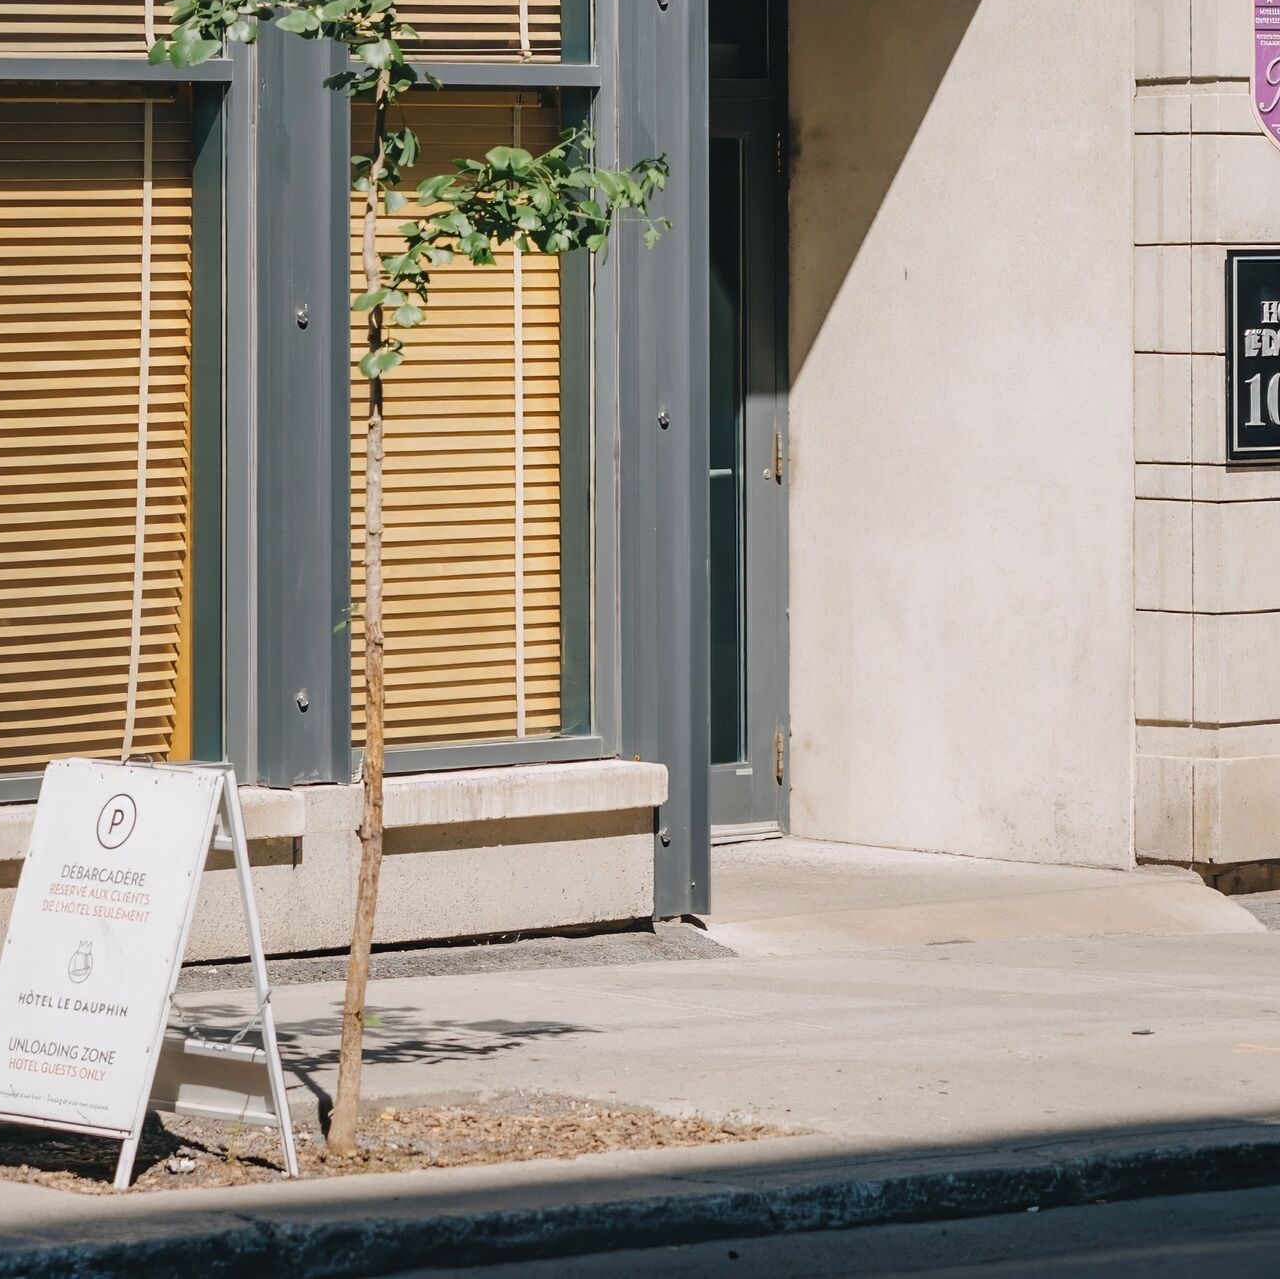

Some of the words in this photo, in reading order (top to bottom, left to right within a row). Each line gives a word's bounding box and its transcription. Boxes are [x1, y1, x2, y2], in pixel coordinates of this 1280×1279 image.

[61, 862, 148, 887] DÉBARCADÈRE
[89, 888, 109, 901] AUX
[110, 890, 151, 906] CLIENTS
[41, 899, 55, 912] DE
[91, 905, 151, 923] SEULEMENT
[19, 991, 54, 1010] HÔTEL
[57, 996, 71, 1010] LE
[73, 999, 130, 1018] DAUPHIN
[8, 1037, 80, 1060] UNLOADING
[80, 1046, 117, 1065] ZONE
[8, 1058, 38, 1073] HOTEL
[41, 1061, 78, 1078] GUESTS
[78, 1067, 108, 1082] ONLY
